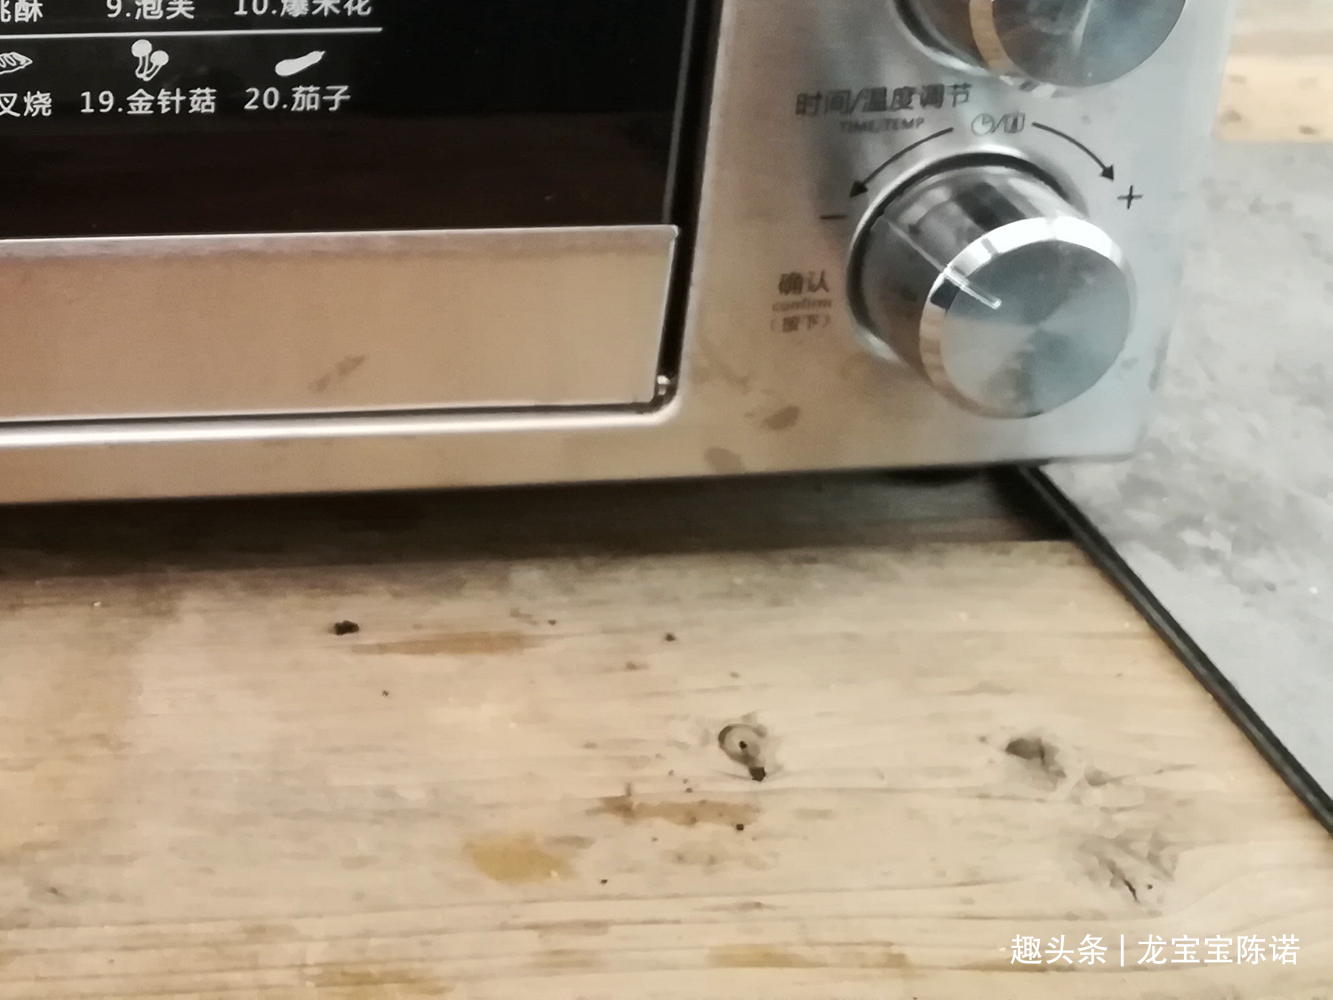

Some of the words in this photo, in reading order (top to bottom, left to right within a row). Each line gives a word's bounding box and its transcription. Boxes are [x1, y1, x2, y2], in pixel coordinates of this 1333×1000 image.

[79, 87, 217, 116] 19.金针菇
[243, 84, 352, 112] 20.茄子
